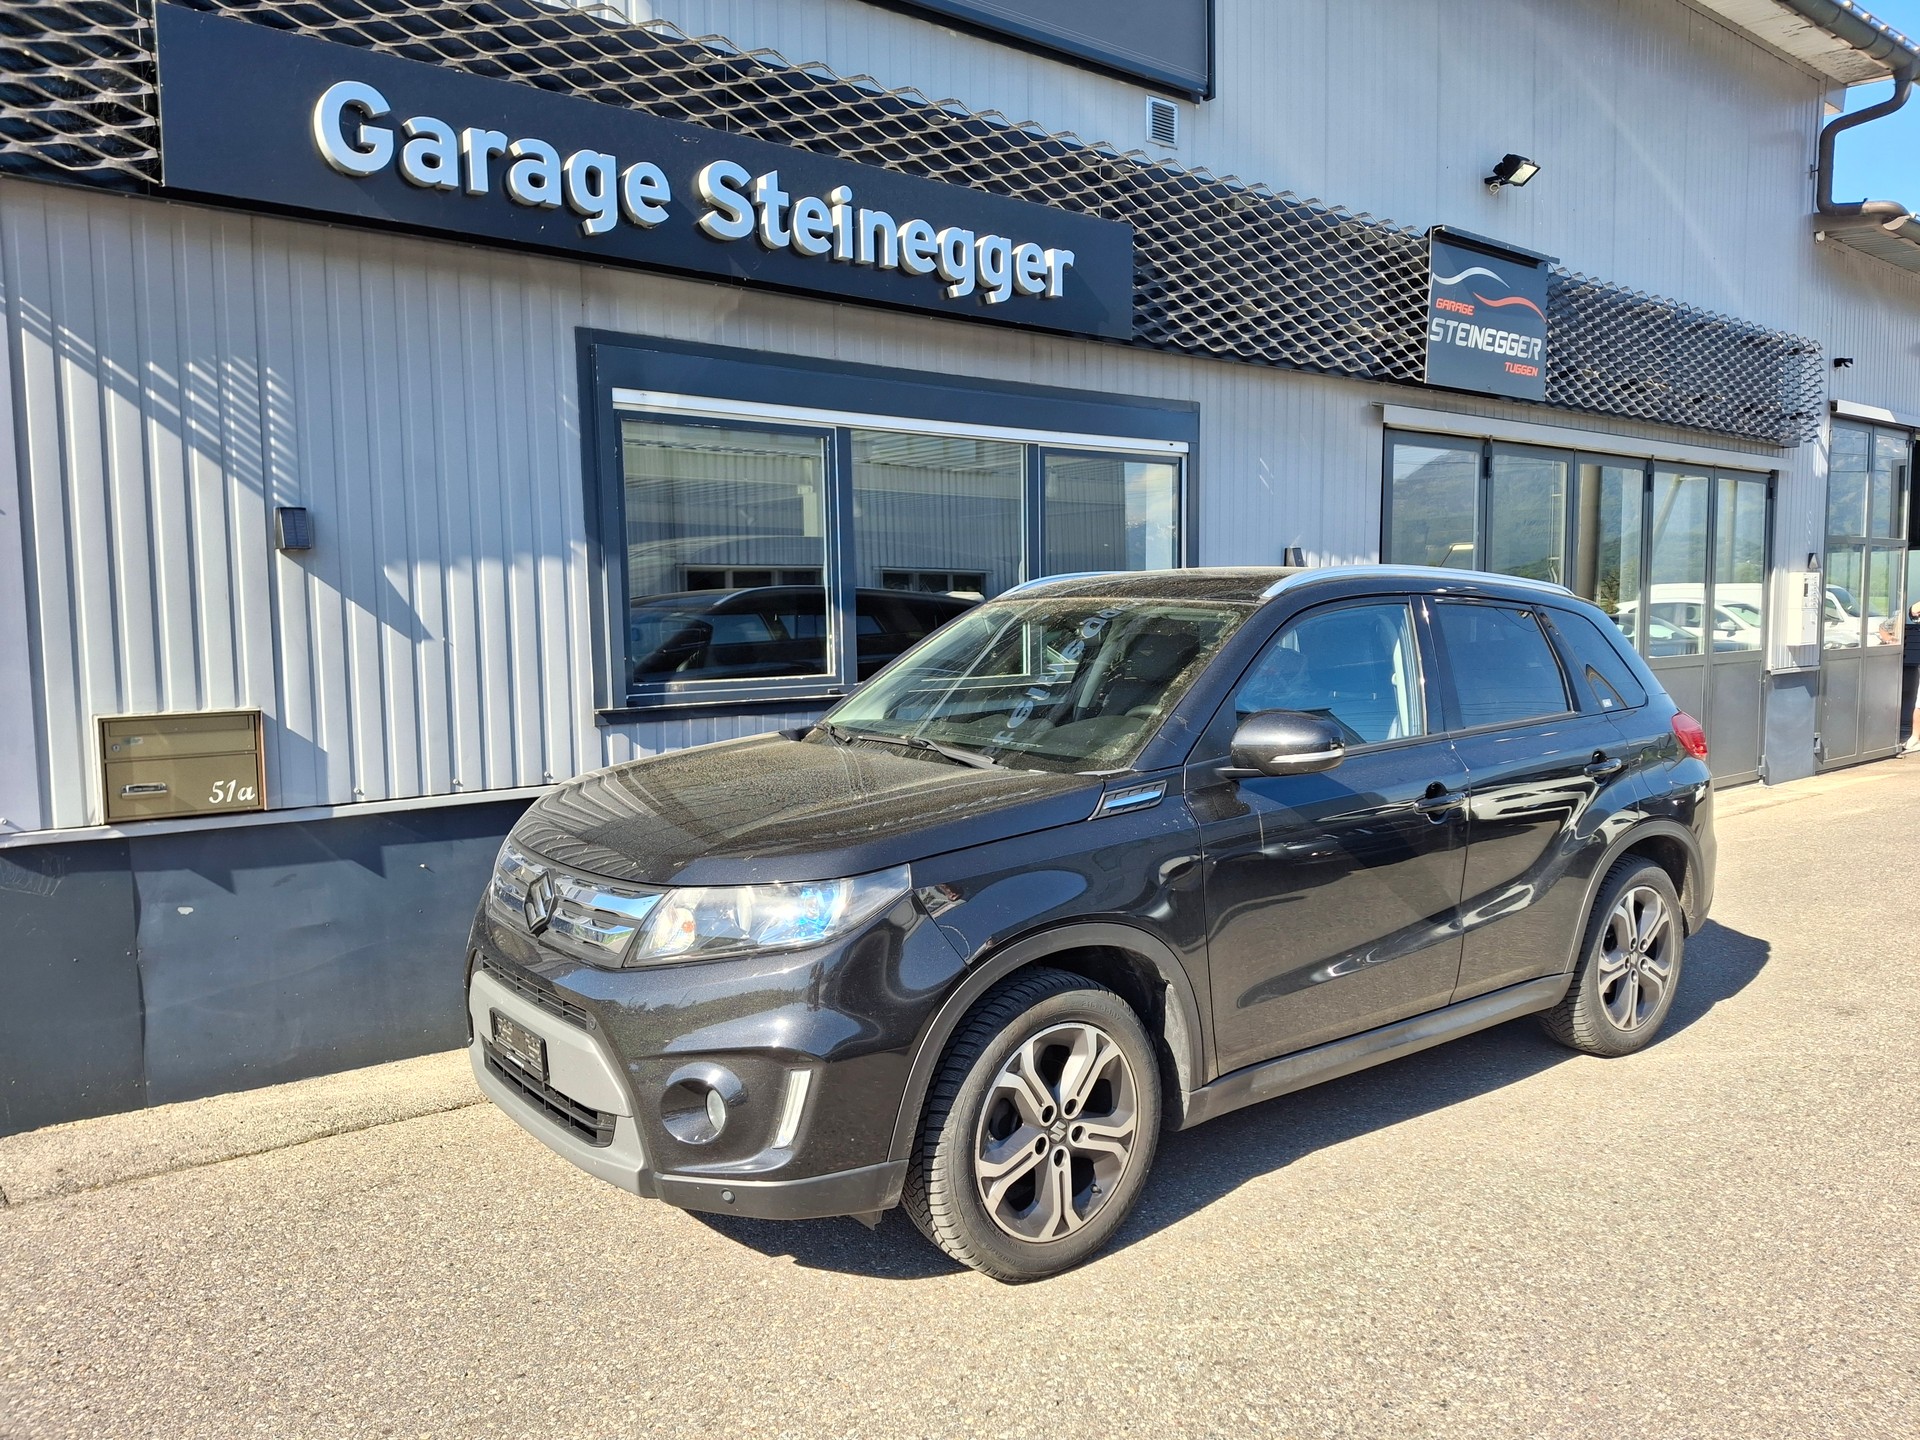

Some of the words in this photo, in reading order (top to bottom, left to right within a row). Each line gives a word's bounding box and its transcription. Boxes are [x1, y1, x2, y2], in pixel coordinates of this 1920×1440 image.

[313, 80, 671, 236] Garage
[697, 158, 1076, 305] Steinegger
[1435, 298, 1475, 315] GARAGE
[1429, 317, 1542, 361] STEINEGGER
[1504, 361, 1539, 377] TUGGEN
[208, 779, 255, 804] 51a
